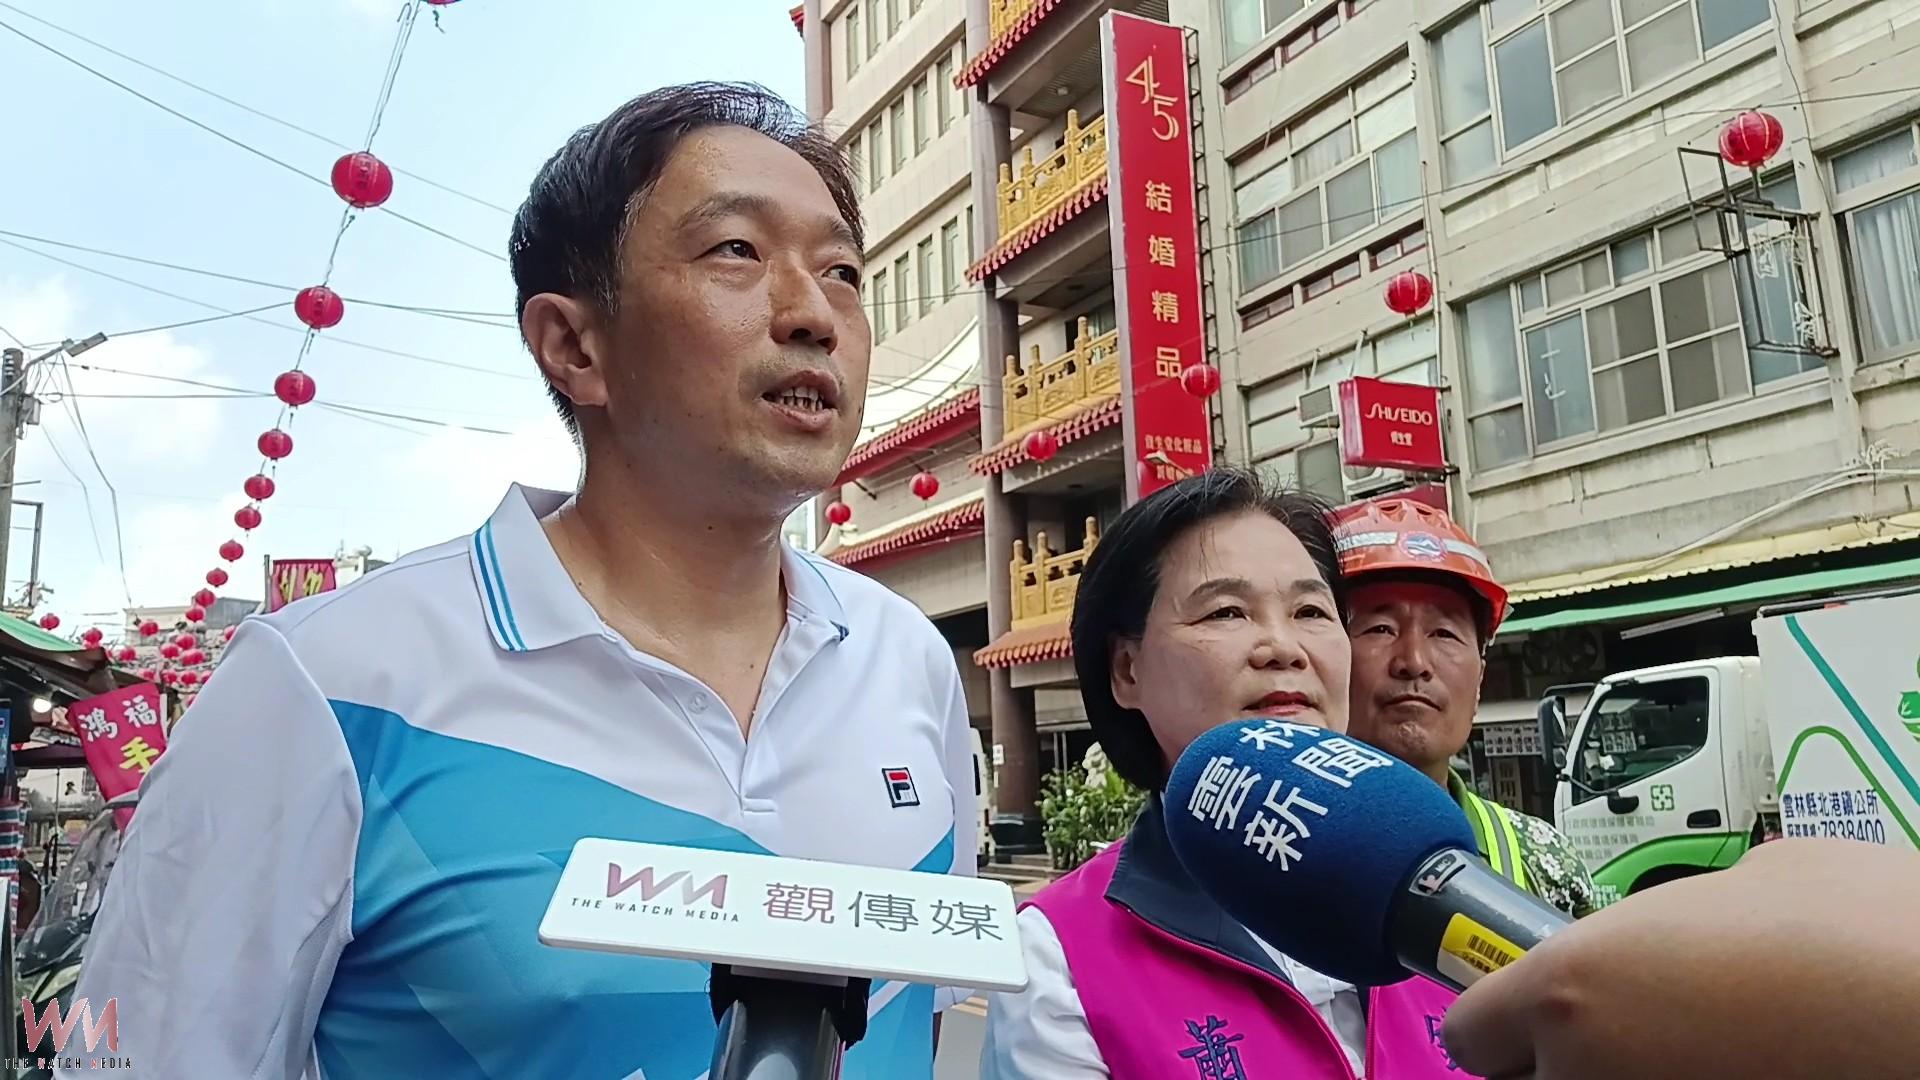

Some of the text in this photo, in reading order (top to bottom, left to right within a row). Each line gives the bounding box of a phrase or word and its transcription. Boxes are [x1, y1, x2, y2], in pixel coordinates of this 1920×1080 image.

[1145, 180, 1183, 379] 結婚精品
[1364, 402, 1433, 426] SHISEIDO
[78, 694, 158, 742] 鴻福
[1187, 720, 1321, 831] 雲林
[1243, 737, 1394, 872] 新聞
[1783, 788, 1879, 818] 雲林縣北港鎮公所
[571, 897, 739, 922] THE WATCH MEDIA
[762, 882, 1003, 941] 觀傳媒
